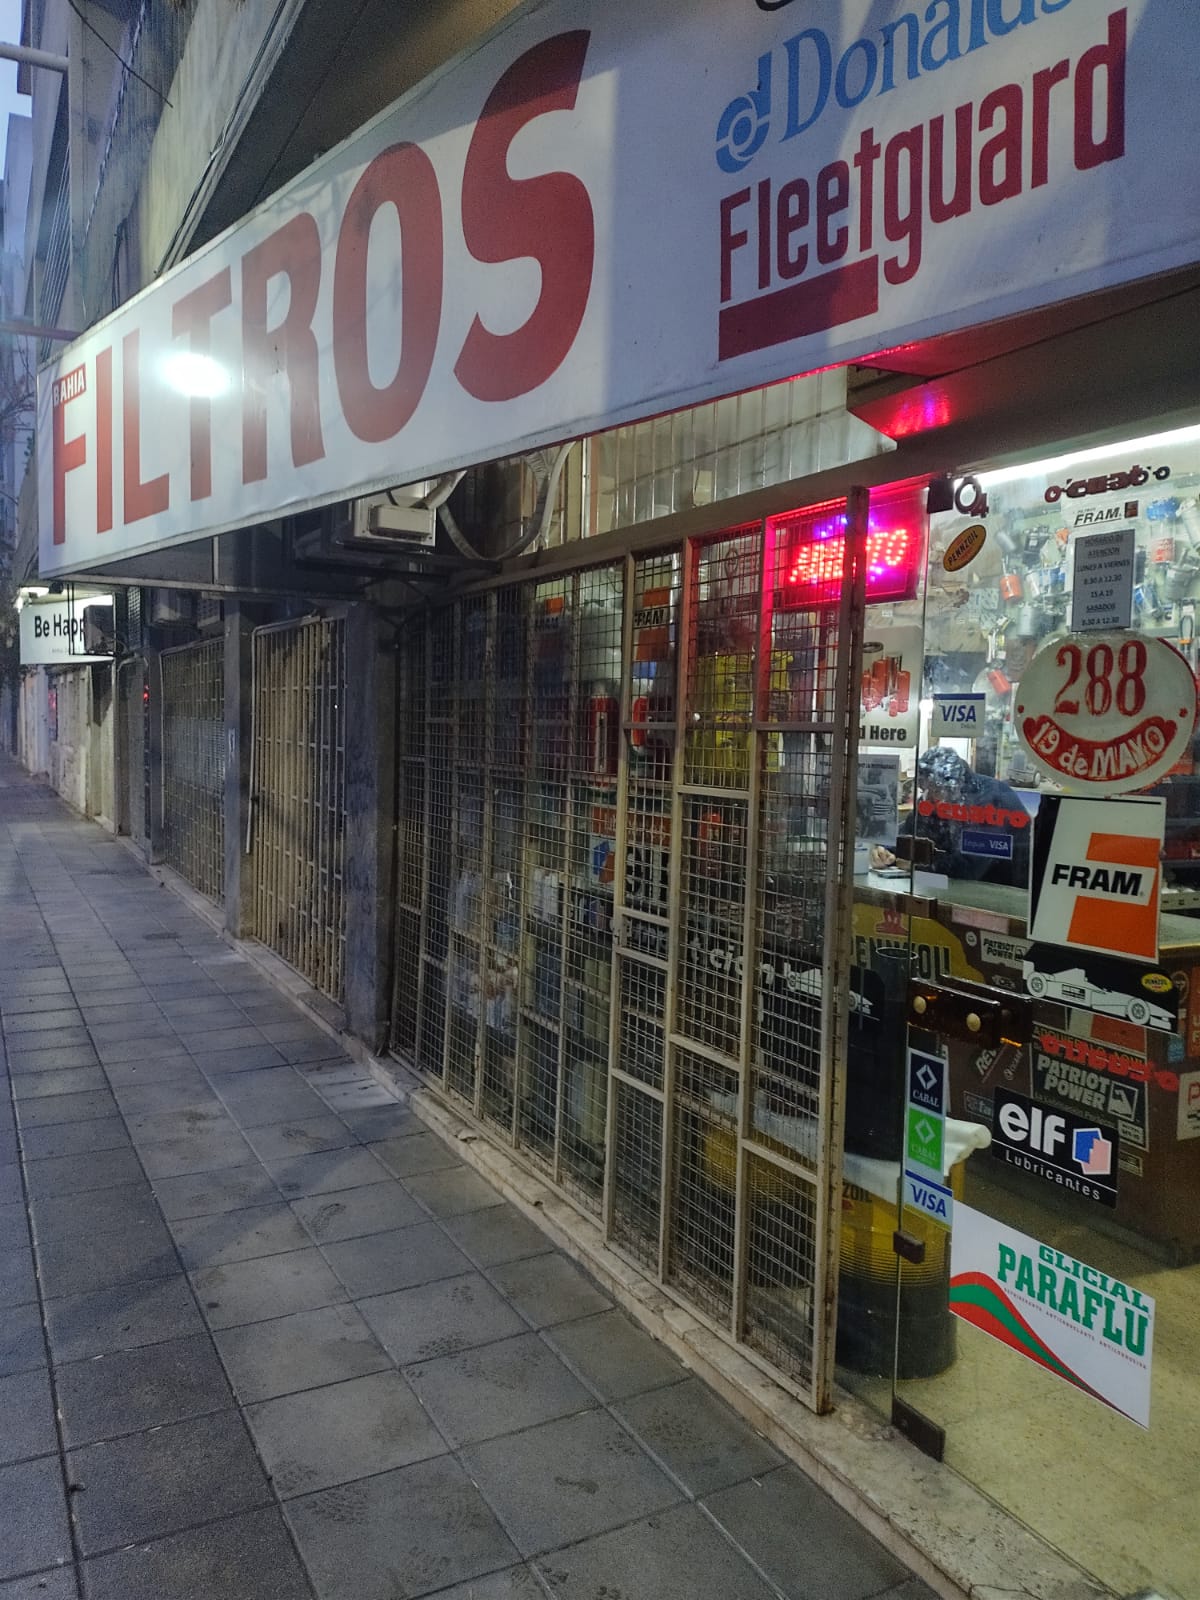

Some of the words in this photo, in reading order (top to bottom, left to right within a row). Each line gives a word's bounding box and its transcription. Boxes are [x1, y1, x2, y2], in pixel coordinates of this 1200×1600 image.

[720, 7, 1128, 303] Fleetguard
[53, 29, 595, 546] FILTROS
[53, 368, 85, 407] BAHIA
[1074, 507, 1121, 525] FRAM
[947, 530, 978, 565] PENNZOIL
[34, 615, 50, 638] Be
[1054, 639, 1147, 716] 288
[939, 704, 977, 722] VISA
[870, 725, 907, 741] Here
[1032, 722, 1060, 754] 19
[1058, 744, 1089, 776] de
[1089, 725, 1165, 777] MAYO
[989, 839, 1009, 850] VISA
[1051, 863, 1142, 897] FRAM
[983, 938, 1014, 952] PATRIOT
[987, 946, 1013, 960] POWER
[1037, 1053, 1110, 1094] PATRIOT
[912, 1089, 940, 1108] CABAL
[1044, 1074, 1106, 1111] POWER
[999, 1102, 1066, 1156] elf
[1006, 1149, 1101, 1201] Lubricantes
[909, 1182, 947, 1217] VISA
[1039, 1245, 1150, 1313] GLICIAL
[997, 1242, 1150, 1357] PARAFLU
